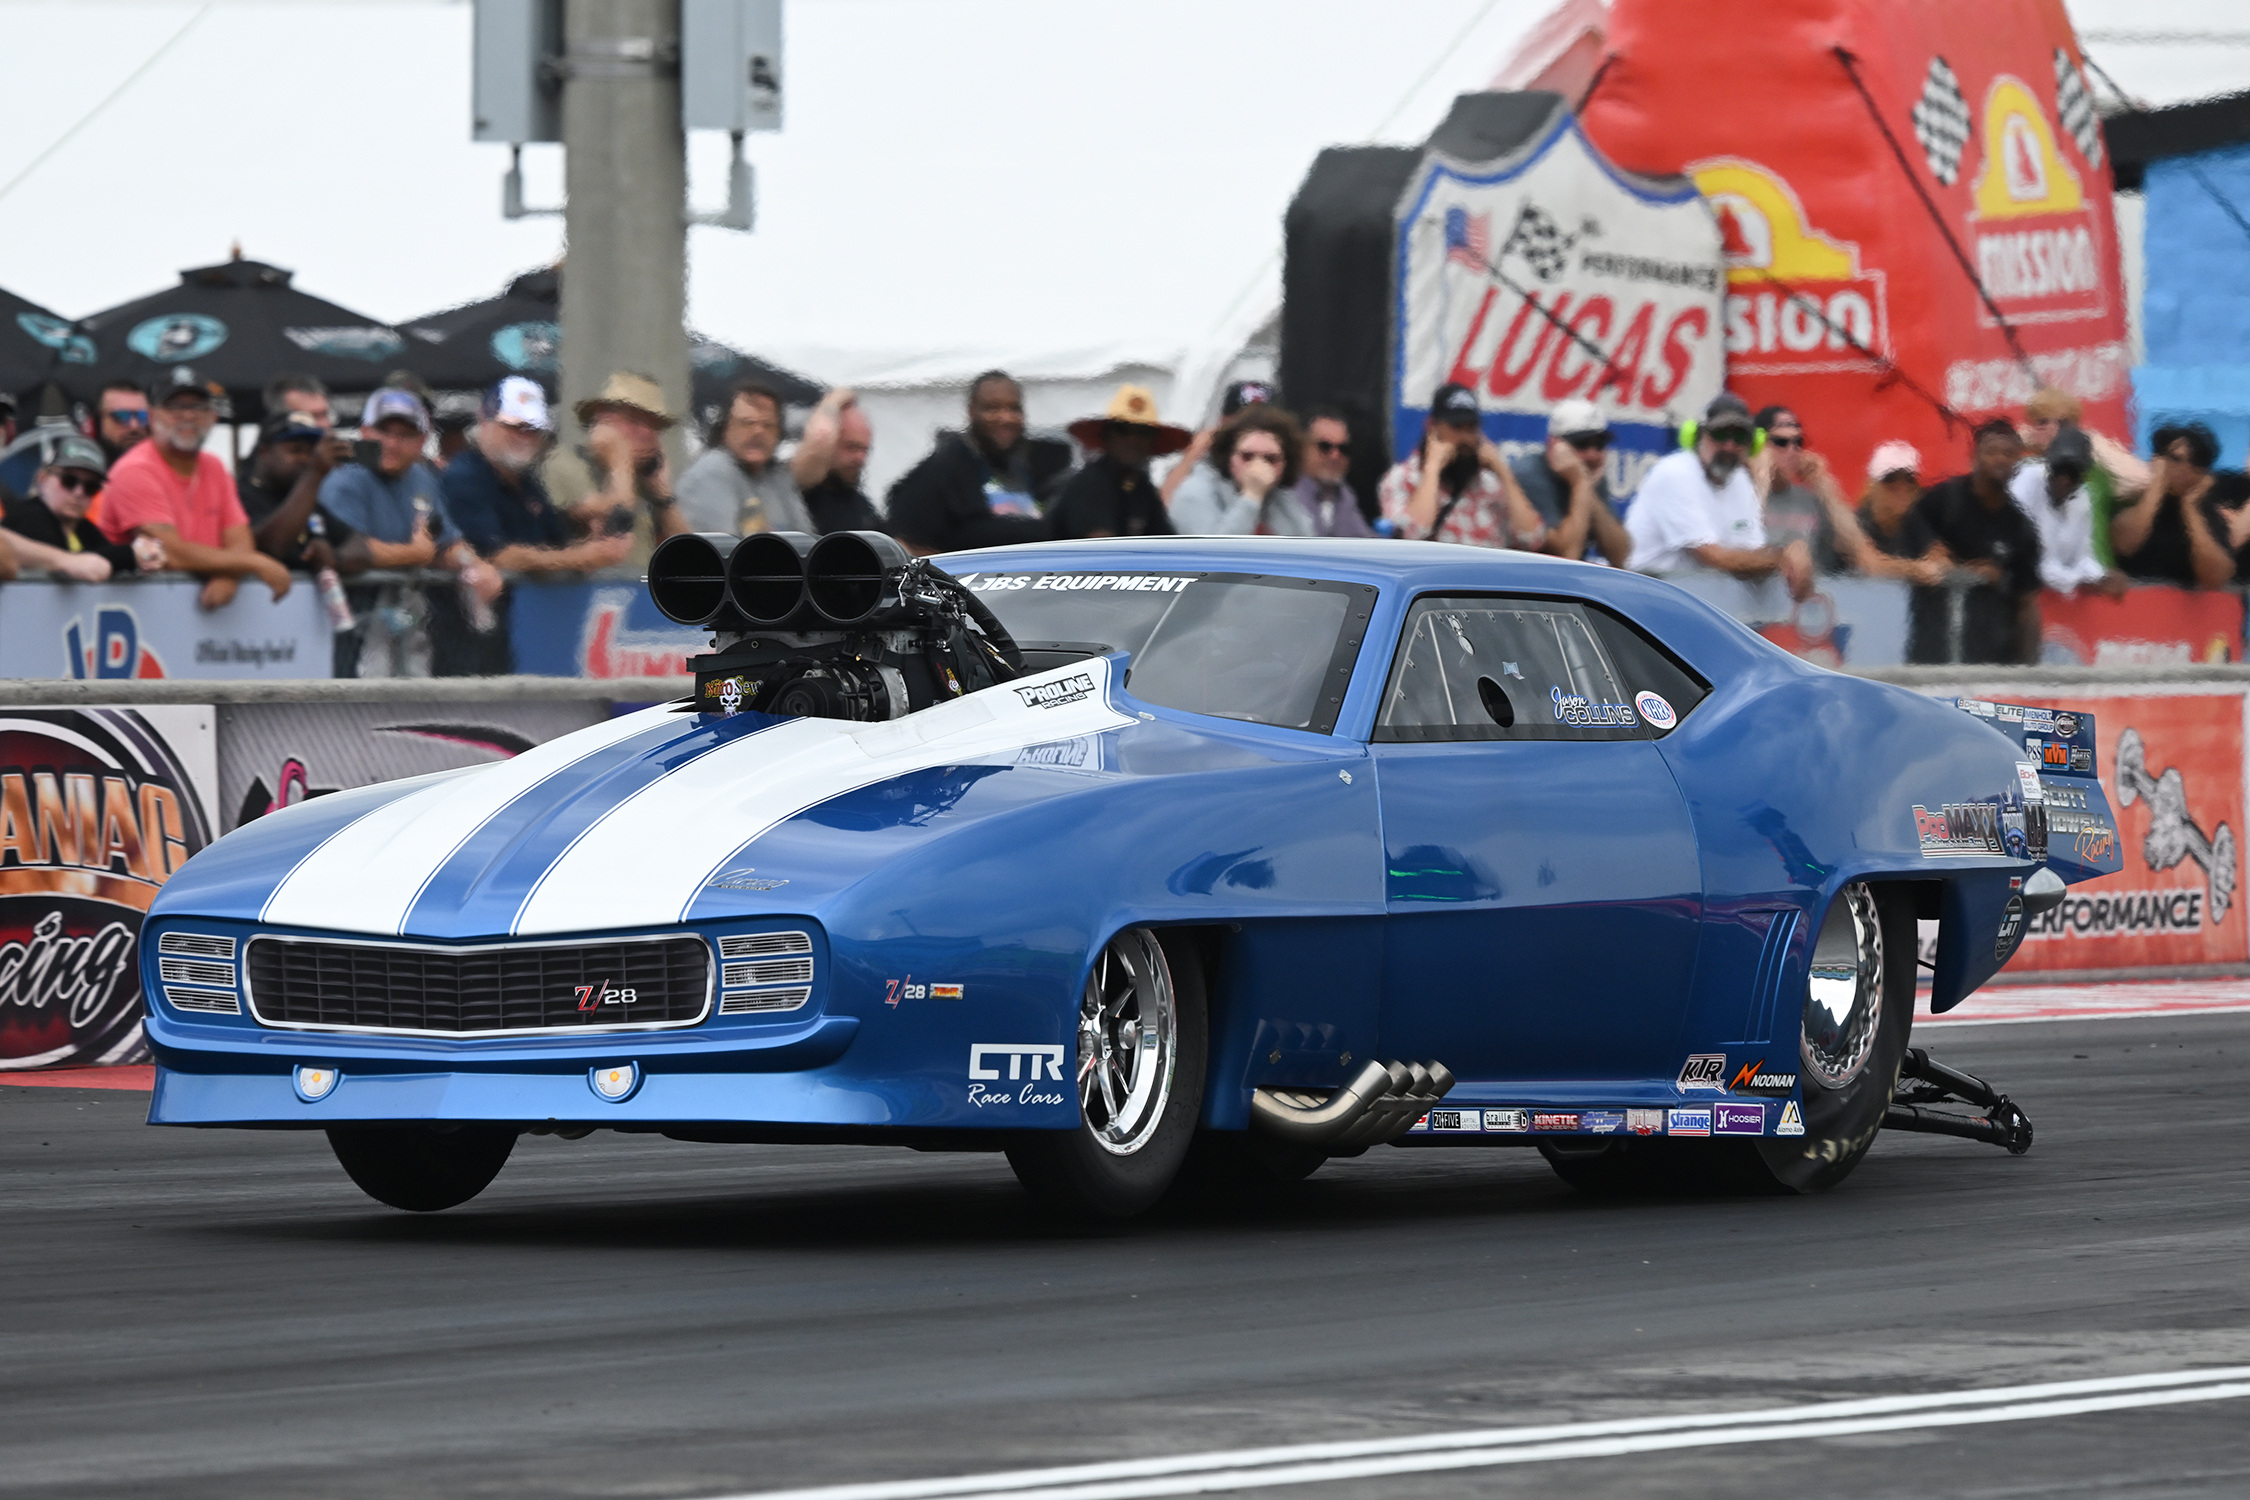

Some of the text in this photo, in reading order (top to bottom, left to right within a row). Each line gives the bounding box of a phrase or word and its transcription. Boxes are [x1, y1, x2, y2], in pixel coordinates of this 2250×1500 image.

[1447, 285, 1708, 409] LUCAS
[970, 576, 1198, 593] JBS EQUIPMENT
[1017, 674, 1094, 706] PROLINE
[1042, 692, 1087, 708] RACING
[1551, 686, 1588, 719] Jason
[1641, 698, 1672, 720] NHRA
[1563, 705, 1636, 725] COLLINS
[1996, 706, 2023, 717] ELITE
[2024, 722, 2054, 732] AUTO GROUP
[2027, 745, 2042, 761] PSS
[575, 979, 637, 1016] Z/28
[885, 974, 926, 1010] Z/28
[968, 1043, 1065, 1081] CTR
[1680, 1059, 1723, 1082] KTR
[1751, 1075, 1796, 1087] NOONAN
[968, 1083, 1065, 1108] Race Cars
[1486, 1112, 1512, 1121] braille
[1534, 1114, 1578, 1125] KINETIC
[1670, 1111, 1709, 1129] Strange
[1729, 1115, 1761, 1124] HOOSIER
